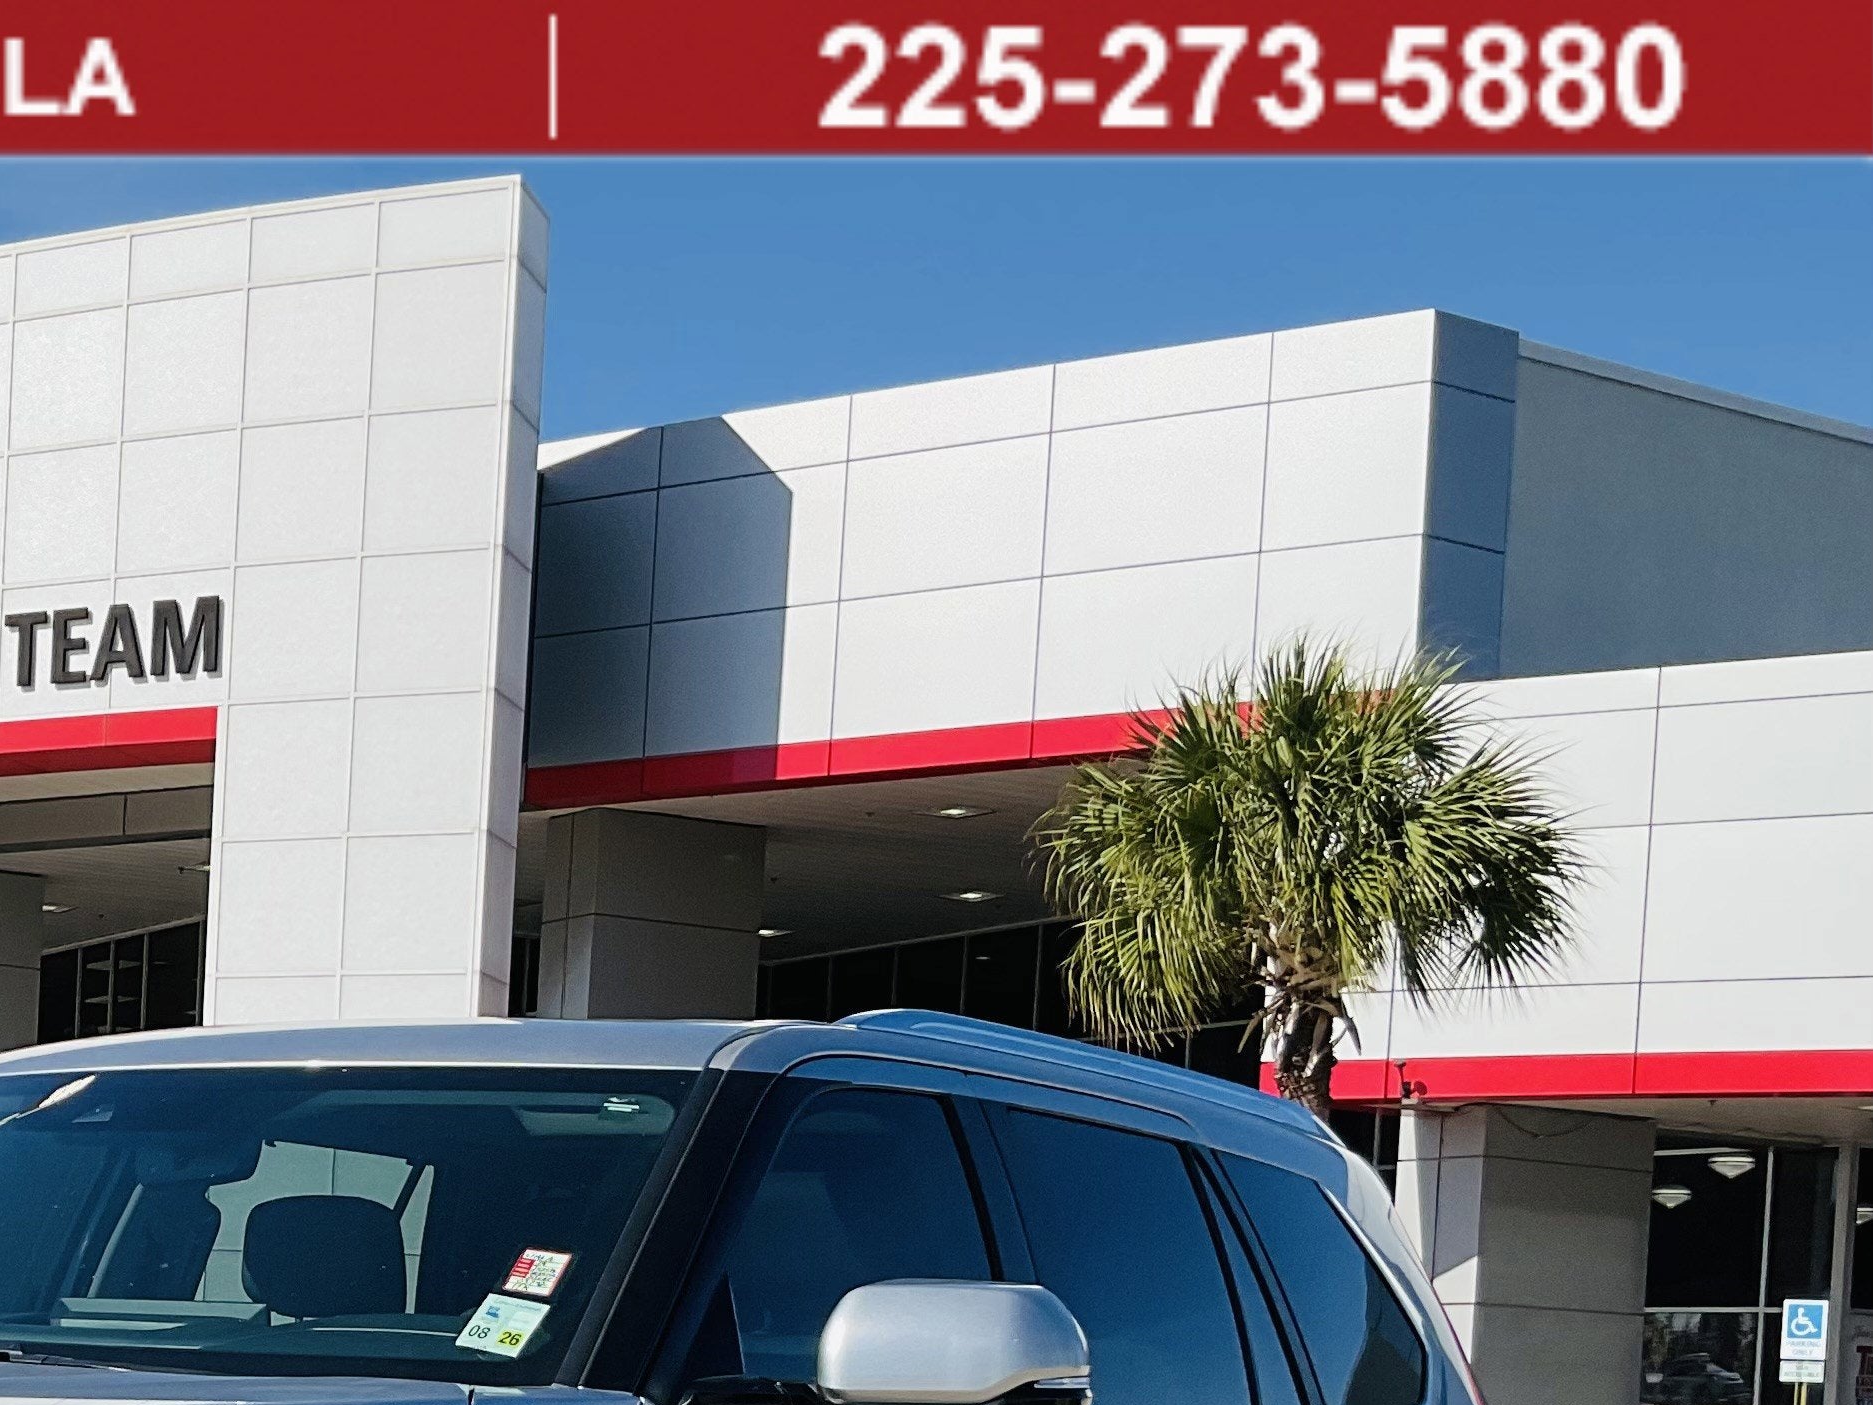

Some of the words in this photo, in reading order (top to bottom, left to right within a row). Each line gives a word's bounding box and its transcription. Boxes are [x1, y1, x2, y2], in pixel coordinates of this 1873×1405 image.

[4, 595, 220, 686] TEAM
[468, 1324, 491, 1339] 08
[498, 1331, 522, 1346] 26
